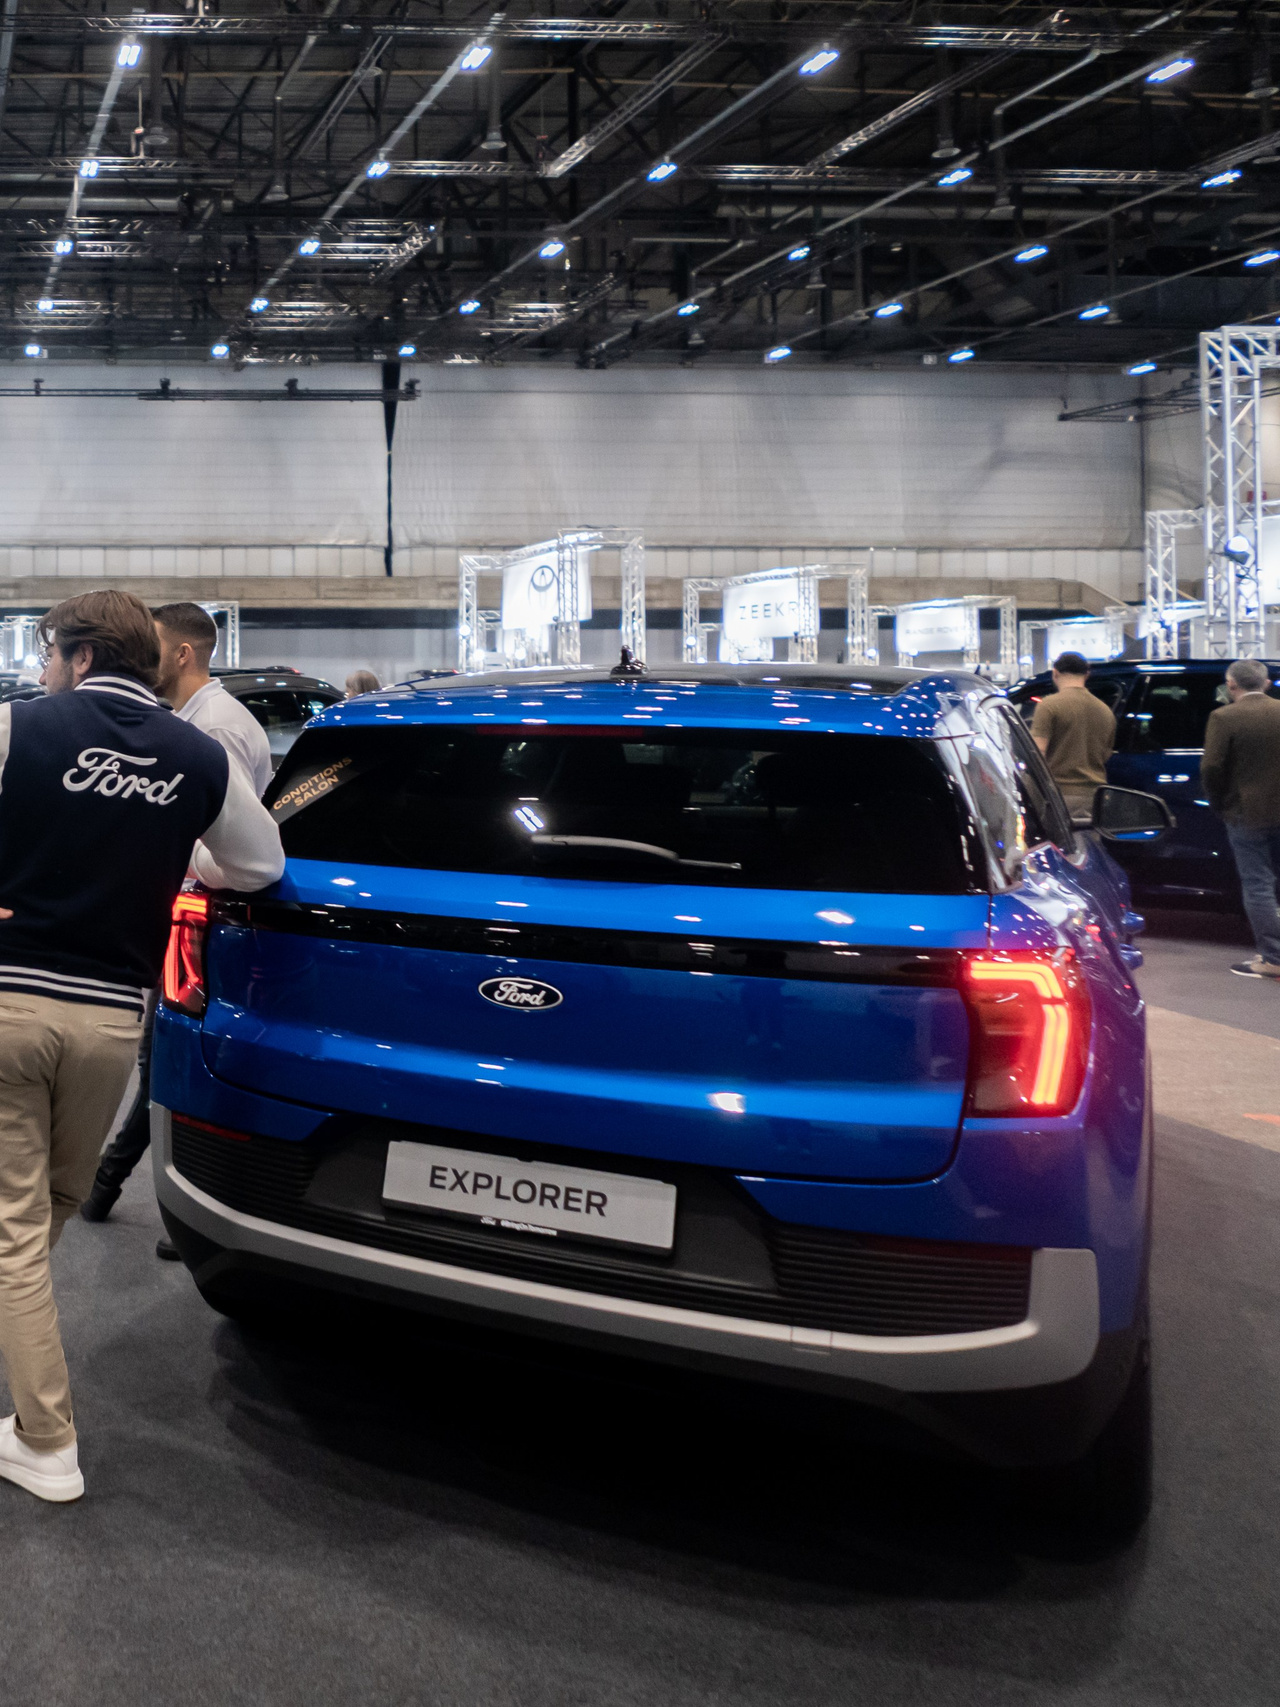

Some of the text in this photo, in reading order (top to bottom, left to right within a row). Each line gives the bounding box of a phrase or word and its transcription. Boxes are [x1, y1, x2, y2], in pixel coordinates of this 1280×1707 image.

[738, 600, 800, 621] ZEEKR
[62, 747, 185, 806] Ford
[273, 757, 353, 811] CONDITIONS
[294, 775, 339, 807] SALON
[494, 981, 547, 1006] Ford
[428, 1164, 609, 1217] EXPLORER
